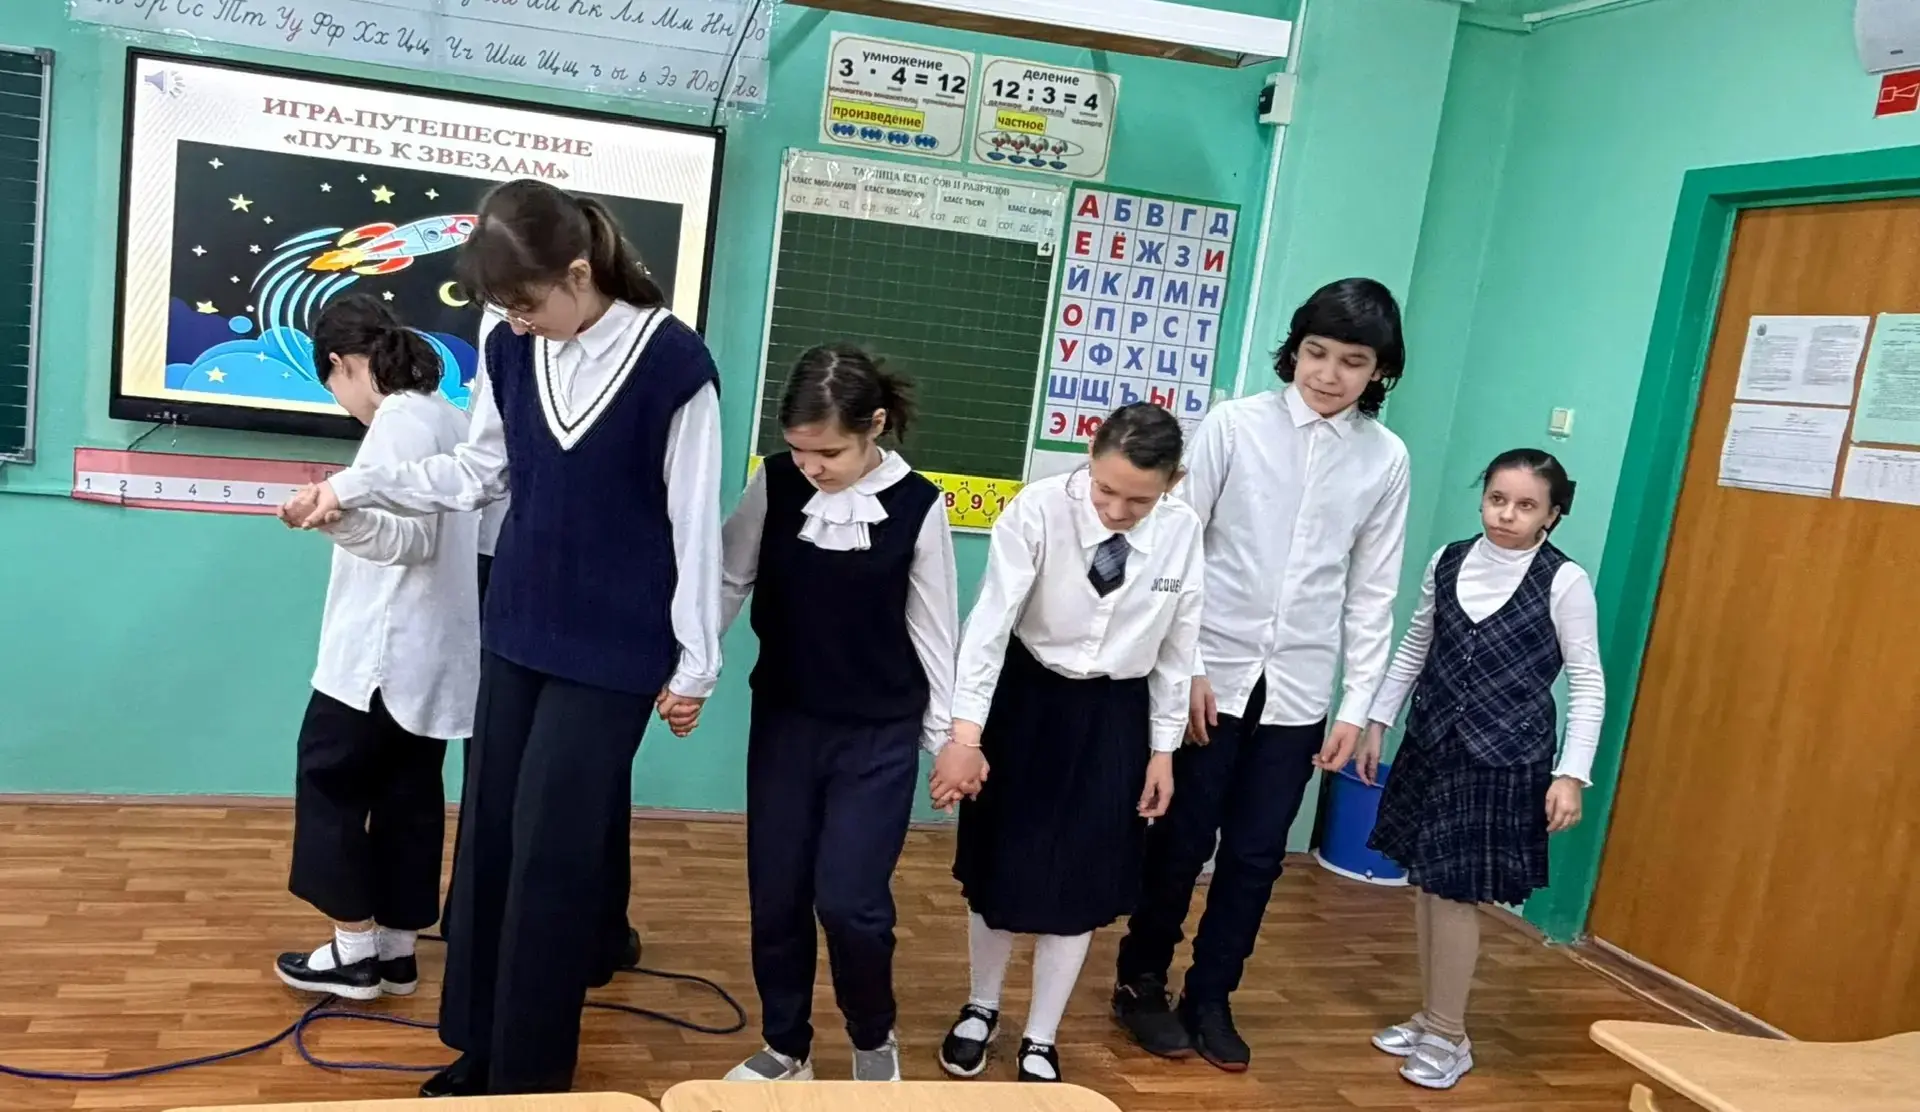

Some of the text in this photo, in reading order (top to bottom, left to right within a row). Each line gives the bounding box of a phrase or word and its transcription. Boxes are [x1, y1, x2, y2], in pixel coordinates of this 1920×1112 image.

[610, 0, 644, 24] Лл
[652, 7, 694, 31] Мм
[701, 12, 735, 37] Нн
[276, 6, 304, 42] Уу
[310, 12, 345, 47] Фф
[353, 21, 389, 45] Хх
[398, 28, 430, 55] Цц
[447, 36, 473, 59] Чч
[485, 42, 527, 67] Шш
[538, 50, 579, 77] Щщ
[590, 64, 602, 77] ъ
[611, 67, 629, 80] ы
[638, 71, 647, 83] ь
[657, 66, 677, 87] Ээ
[686, 70, 719, 93] Юю
[862, 51, 943, 71] умножение
[839, 58, 854, 77] 3
[891, 67, 907, 85] 4
[914, 73, 929, 85] =
[938, 74, 966, 94] 12
[1023, 69, 1080, 86] деление
[992, 79, 1020, 99] 12
[1042, 87, 1056, 104] 3
[1064, 93, 1077, 104] =
[1084, 93, 1099, 110] 4
[262, 97, 593, 157] ИГРА-ПУТЕШЕСТВИЕ
[833, 105, 922, 129] произведение
[997, 116, 1045, 131] частное
[283, 129, 569, 180] «ПУТЬ К ЗВЕЗДАМ»
[852, 167, 900, 181] ТАЛИЦА
[1077, 195, 1229, 237] А Б В Г Д
[1041, 243, 1050, 253] 4
[1075, 231, 1225, 272] Е Ё Ж З И
[1067, 264, 1220, 308] Й К Л М Н
[1063, 304, 1212, 342] О П Р С Т
[1059, 338, 1208, 377] У Ф Х Ц Ч
[1048, 375, 1201, 412] Ш Щ Ъ Ы Ь
[1049, 412, 1066, 434] Э
[84, 478, 265, 499] 1 2 3 4 5 6
[945, 492, 955, 507] 8
[971, 494, 983, 510] 9
